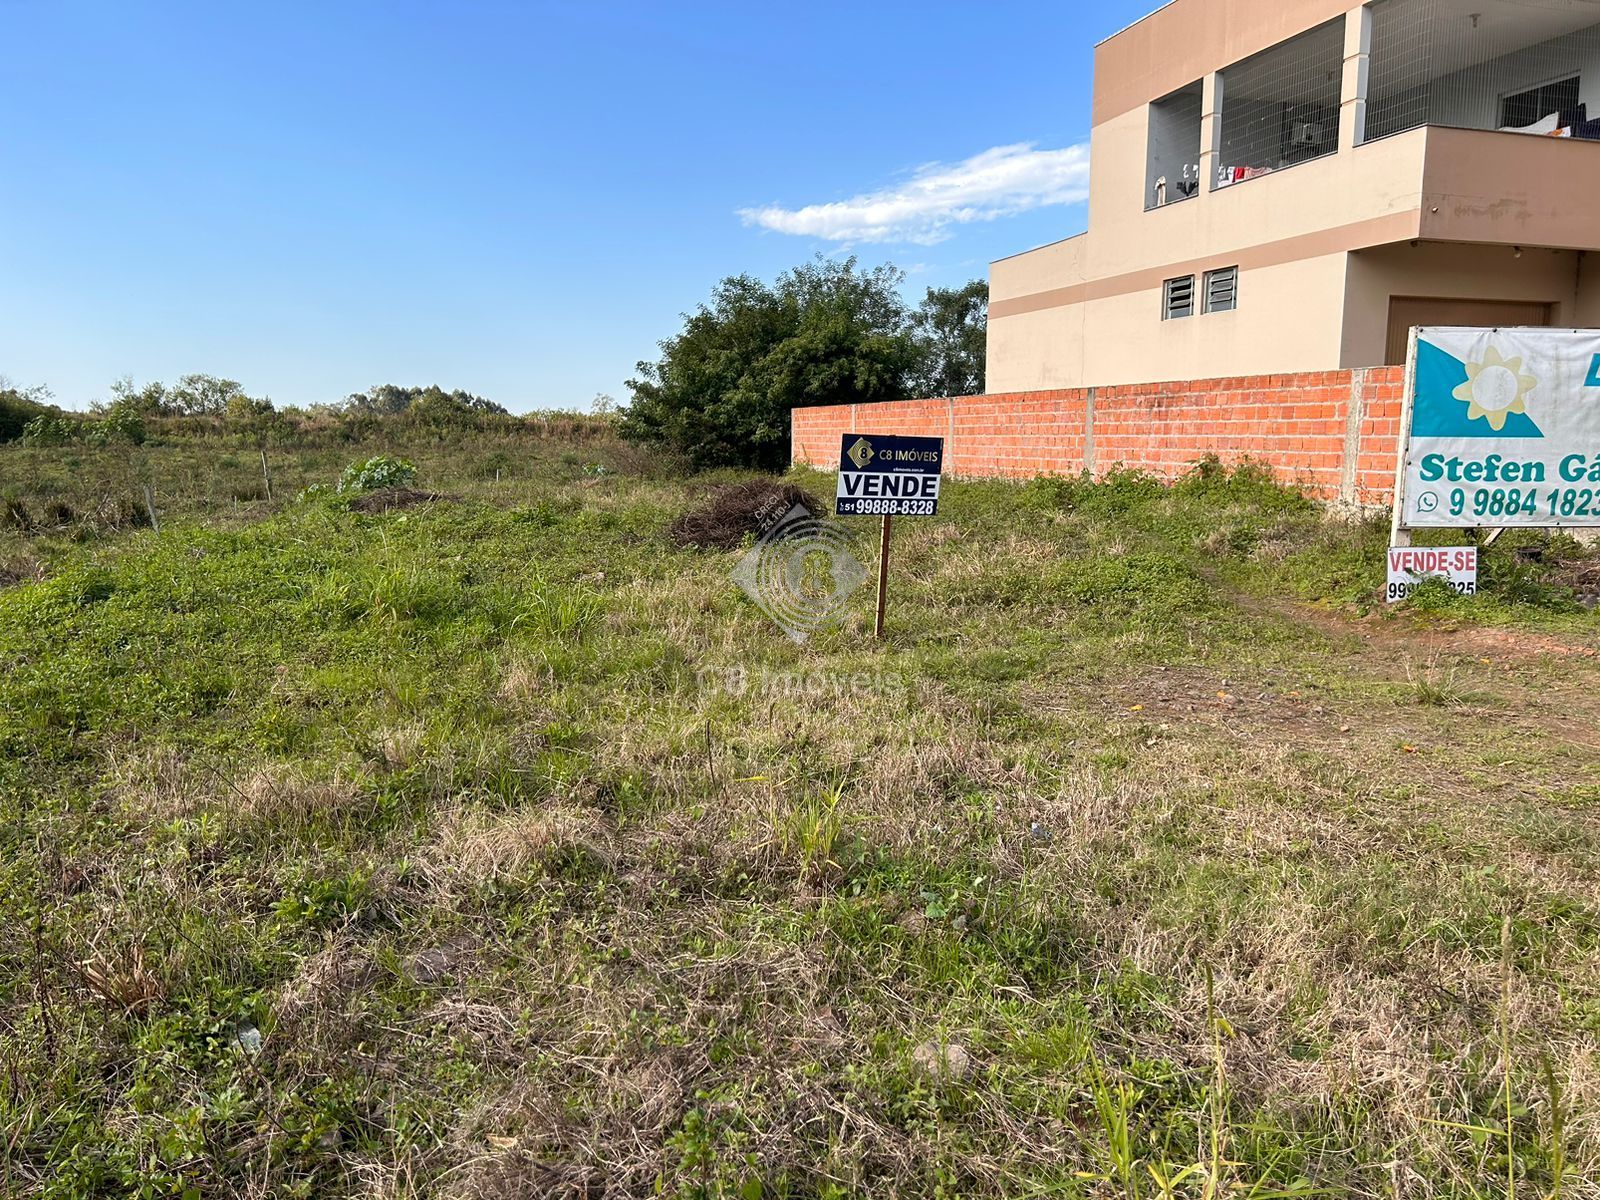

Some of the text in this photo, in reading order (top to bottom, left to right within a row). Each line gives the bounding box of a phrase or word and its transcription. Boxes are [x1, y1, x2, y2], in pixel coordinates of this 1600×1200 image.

[879, 447, 939, 462] C8 IMÓVEIS
[1419, 454, 1546, 483] Stefen
[843, 474, 937, 497] VENDE
[844, 499, 934, 515] 51 99888-8328
[1449, 488, 1465, 516] 9
[1473, 488, 1537, 516] 9884
[1389, 551, 1476, 572] VENDE-SE
